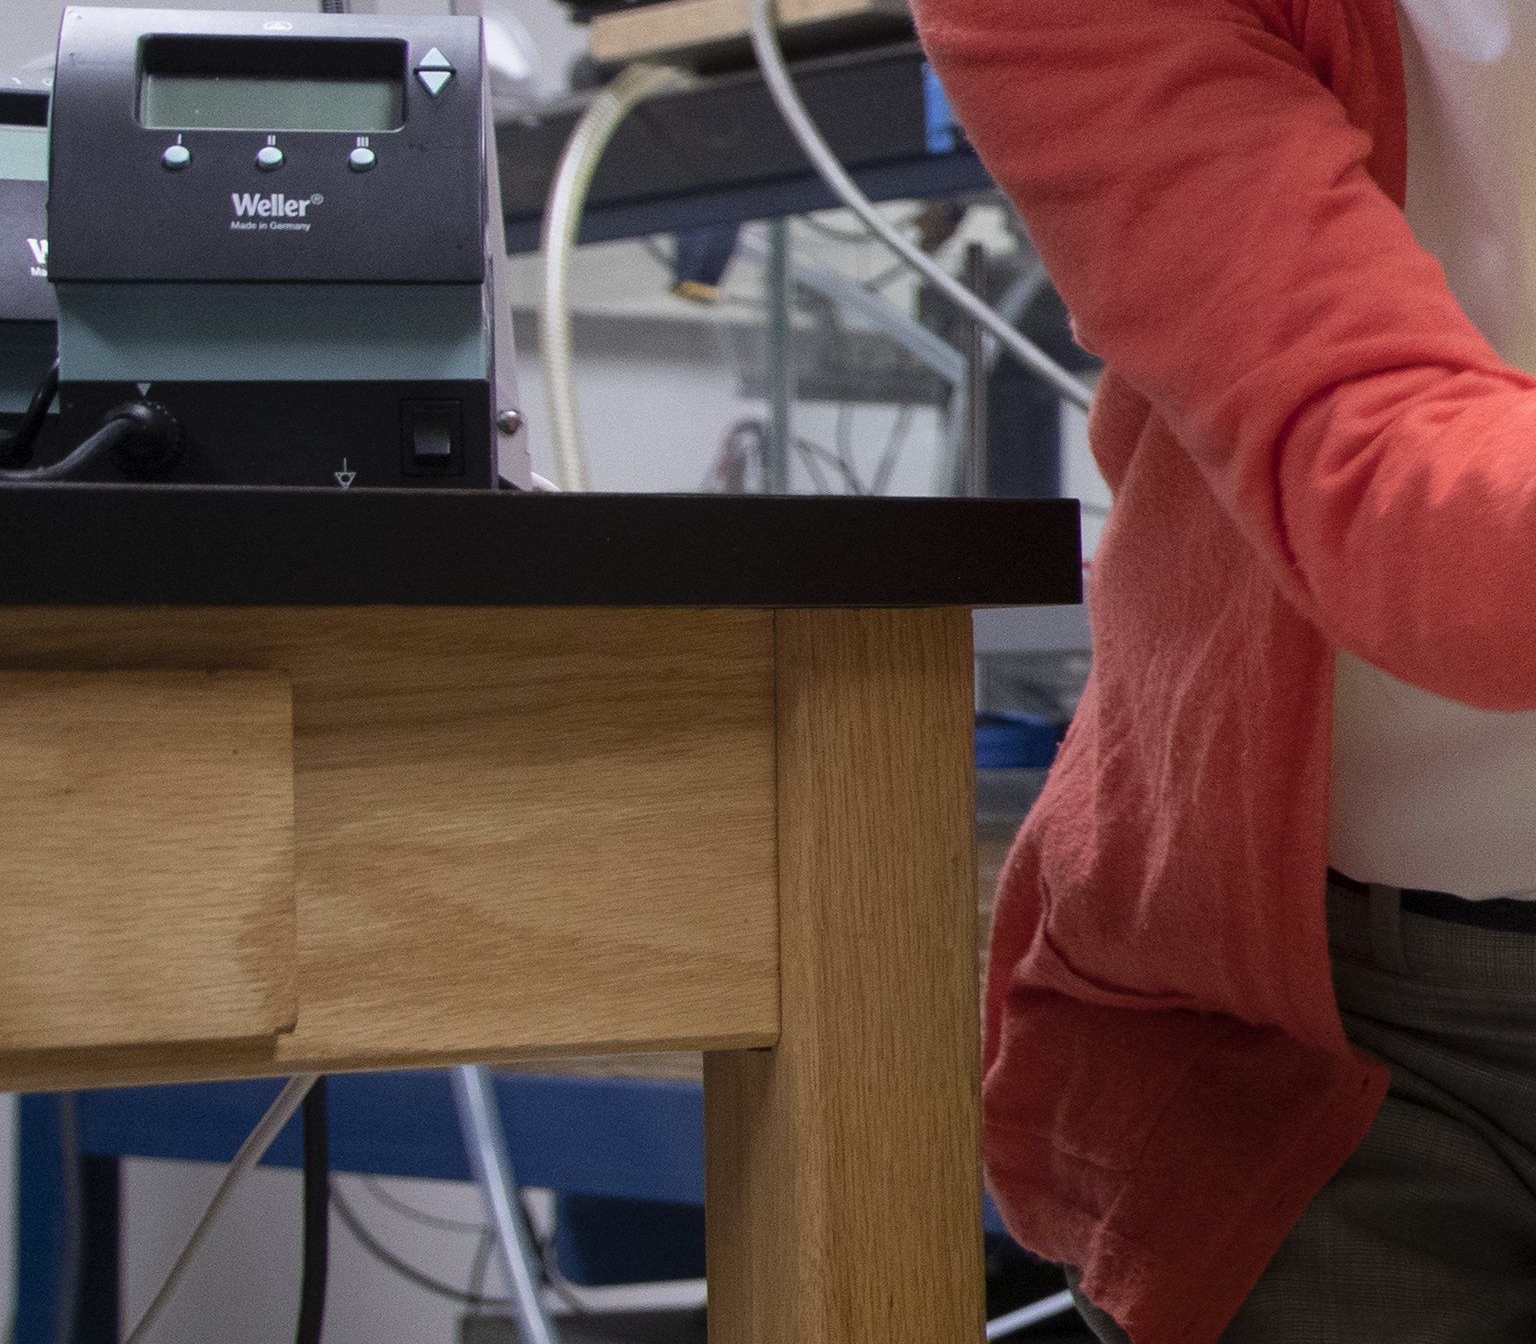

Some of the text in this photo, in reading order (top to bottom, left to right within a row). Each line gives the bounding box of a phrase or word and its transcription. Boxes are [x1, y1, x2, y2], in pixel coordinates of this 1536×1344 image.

[230, 220, 311, 232] Made in Germany
